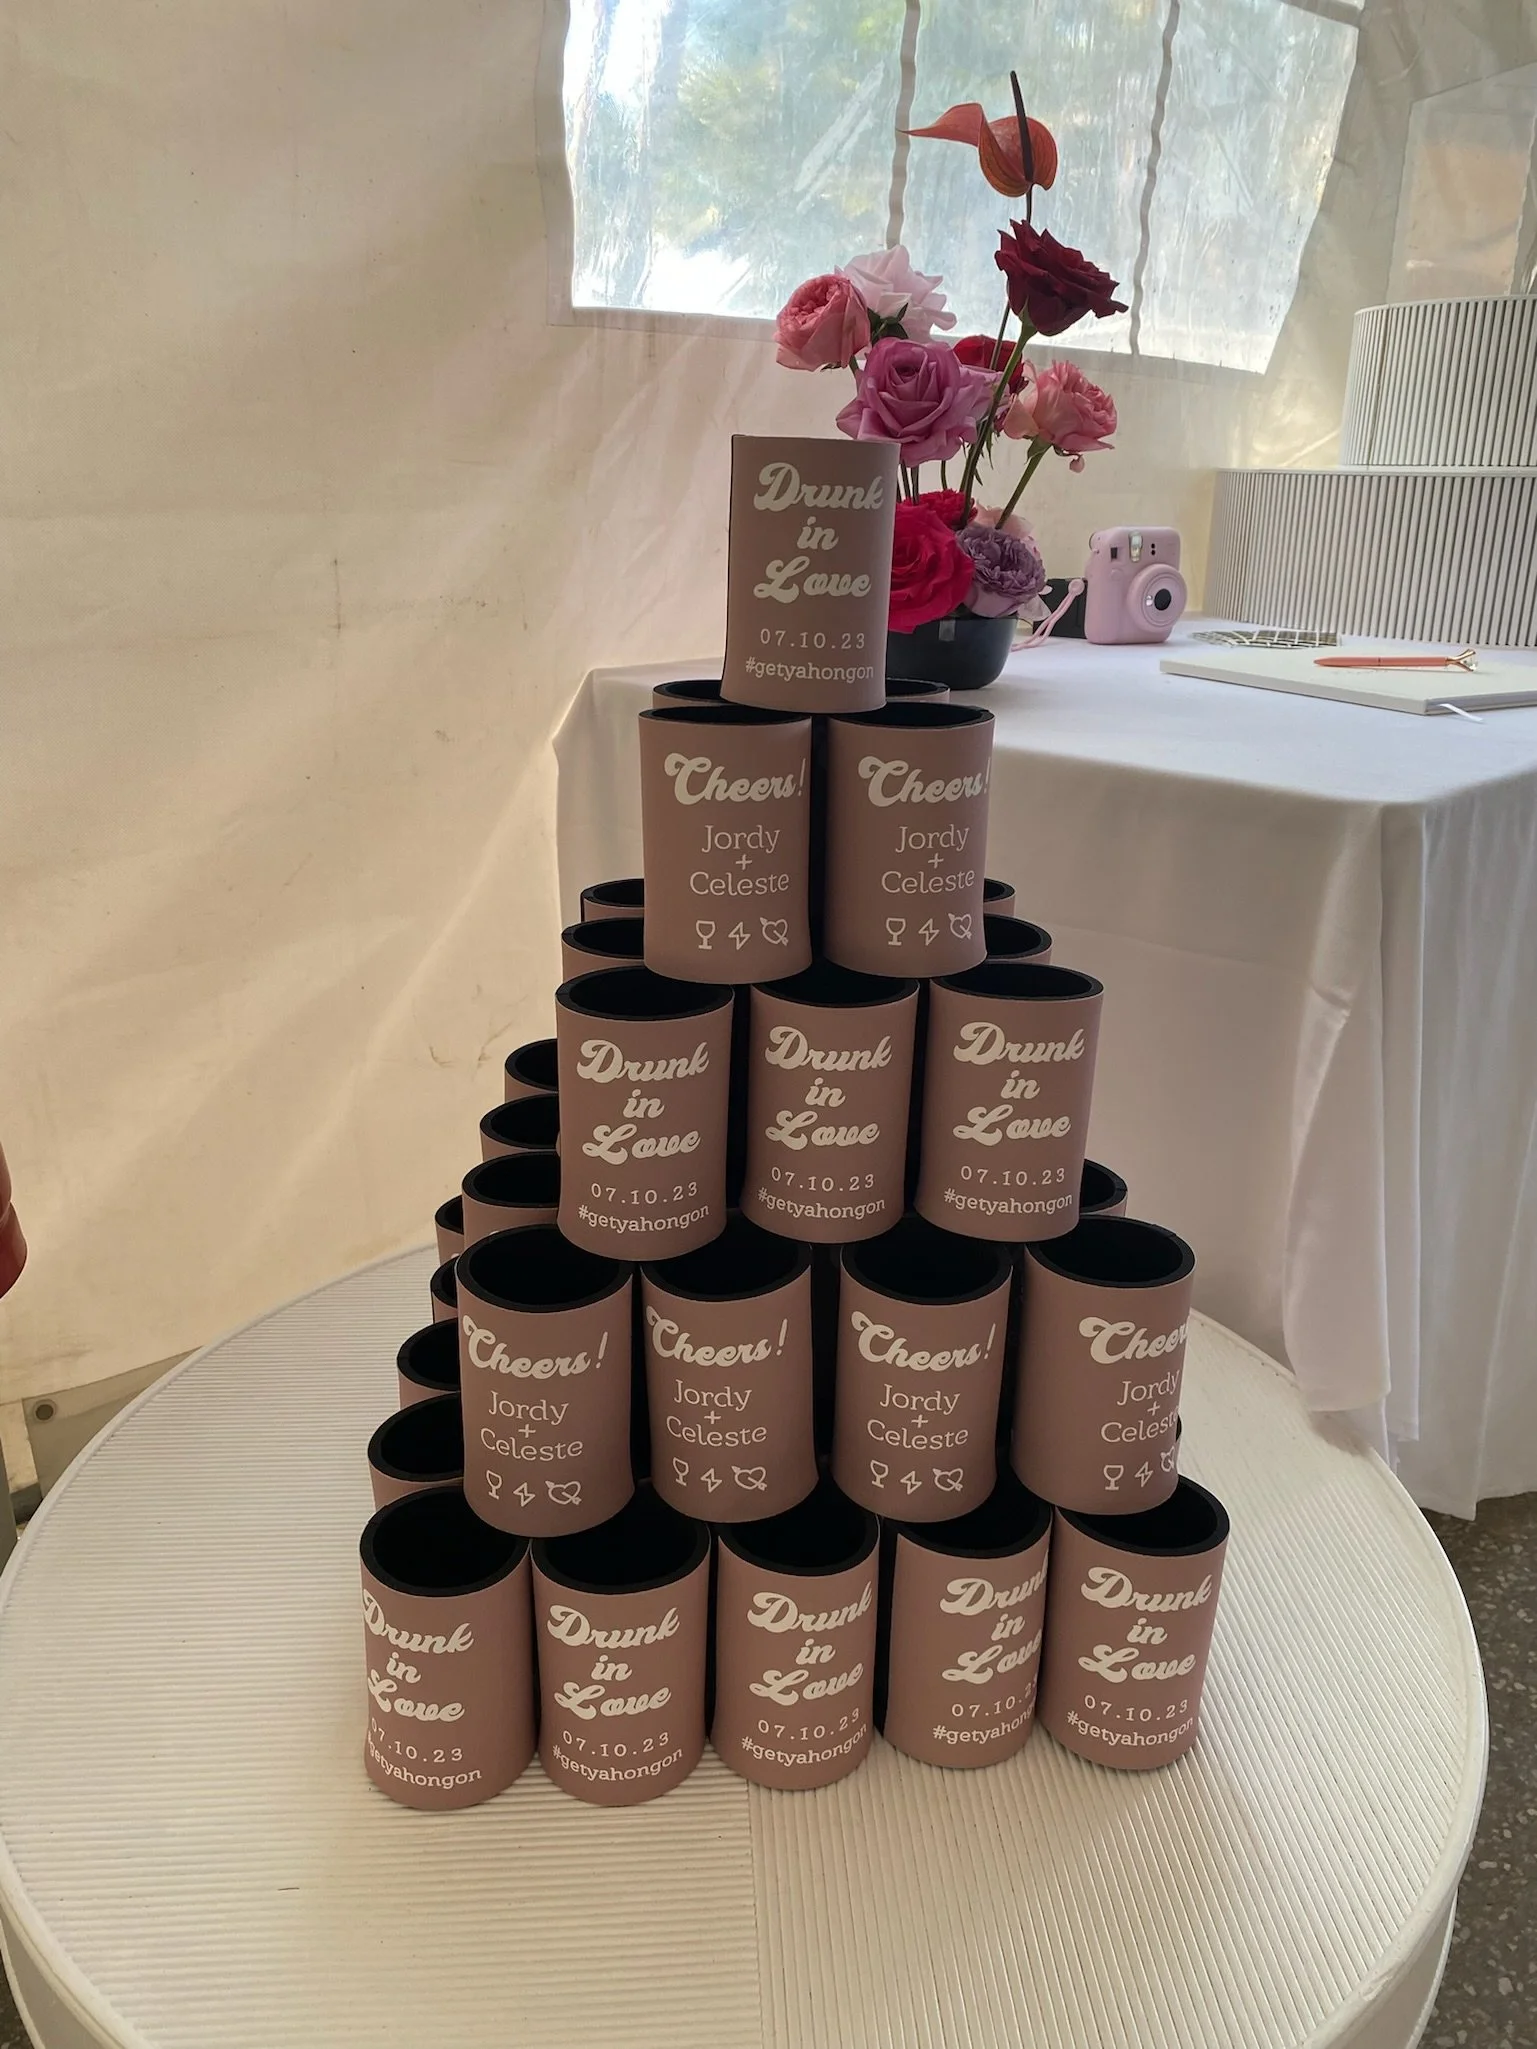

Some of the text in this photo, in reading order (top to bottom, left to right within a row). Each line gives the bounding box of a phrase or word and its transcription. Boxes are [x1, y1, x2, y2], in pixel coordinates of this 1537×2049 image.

[754, 462, 884, 511] Drunk
[797, 516, 839, 550] in
[753, 556, 871, 603] Love
[760, 628, 866, 649] 07.10.23
[746, 656, 874, 683] #getyahongon
[664, 752, 806, 805] Cheers!
[858, 756, 991, 807] Cheers!
[702, 825, 780, 853] Jordy
[895, 824, 969, 853] Jordy
[735, 854, 752, 870] +
[927, 853, 944, 868] +
[689, 871, 789, 896] Celeste
[881, 869, 975, 894] Celeste
[765, 1026, 892, 1071] Drunk
[953, 1021, 1085, 1065] Drunk
[576, 1039, 709, 1083] Drunk
[805, 1078, 845, 1108] in
[1000, 1070, 1040, 1099] in
[623, 1089, 664, 1118] in
[765, 1110, 880, 1150] Love
[953, 1104, 1071, 1146] Love
[582, 1123, 701, 1165] Love
[771, 1167, 874, 1192] 07.10.23
[961, 1166, 1065, 1186] 07.10.23
[591, 1182, 697, 1205] 07.10.23
[758, 1187, 885, 1219] #getyahongon
[944, 1187, 1073, 1216] #getyahongon
[578, 1205, 709, 1233] #getyahongon
[462, 1314, 608, 1380] Cheers!
[646, 1306, 788, 1367] Cheers!
[851, 1310, 996, 1372] Cheers!
[674, 1379, 752, 1411] Jordy
[880, 1384, 960, 1416] Jordy
[1117, 1369, 1180, 1406] Jordy
[488, 1391, 569, 1426] Jordy
[704, 1410, 721, 1425] +
[911, 1414, 929, 1428] +
[1147, 1401, 1161, 1416] +
[480, 1427, 583, 1461] Celeste
[518, 1424, 536, 1438] +
[666, 1415, 767, 1447] Celeste
[867, 1419, 968, 1450] Celeste
[1081, 1566, 1212, 1612] Drunk
[363, 1588, 474, 1654] Drunk
[747, 1580, 872, 1633] Drunk
[547, 1604, 680, 1649] Drunk
[991, 1613, 1025, 1641] in
[1127, 1618, 1167, 1644] in
[386, 1652, 421, 1683] in
[795, 1638, 836, 1665] in
[1078, 1644, 1196, 1683] Love
[591, 1655, 632, 1681] in
[368, 1669, 465, 1721] Love
[749, 1663, 863, 1706] Love
[952, 1673, 1037, 1718] 07.10.2
[554, 1682, 671, 1720] Love
[1084, 1695, 1188, 1722] 07.10.23
[371, 1717, 463, 1763] 07.10.23
[758, 1708, 859, 1740] 07.10.23
[1067, 1710, 1194, 1747] #getyahongon
[367, 1730, 482, 1789] getyahongon
[562, 1730, 669, 1757] 07.10.23
[741, 1724, 867, 1767] #getyahongon
[552, 1747, 683, 1781] #getyahongon
